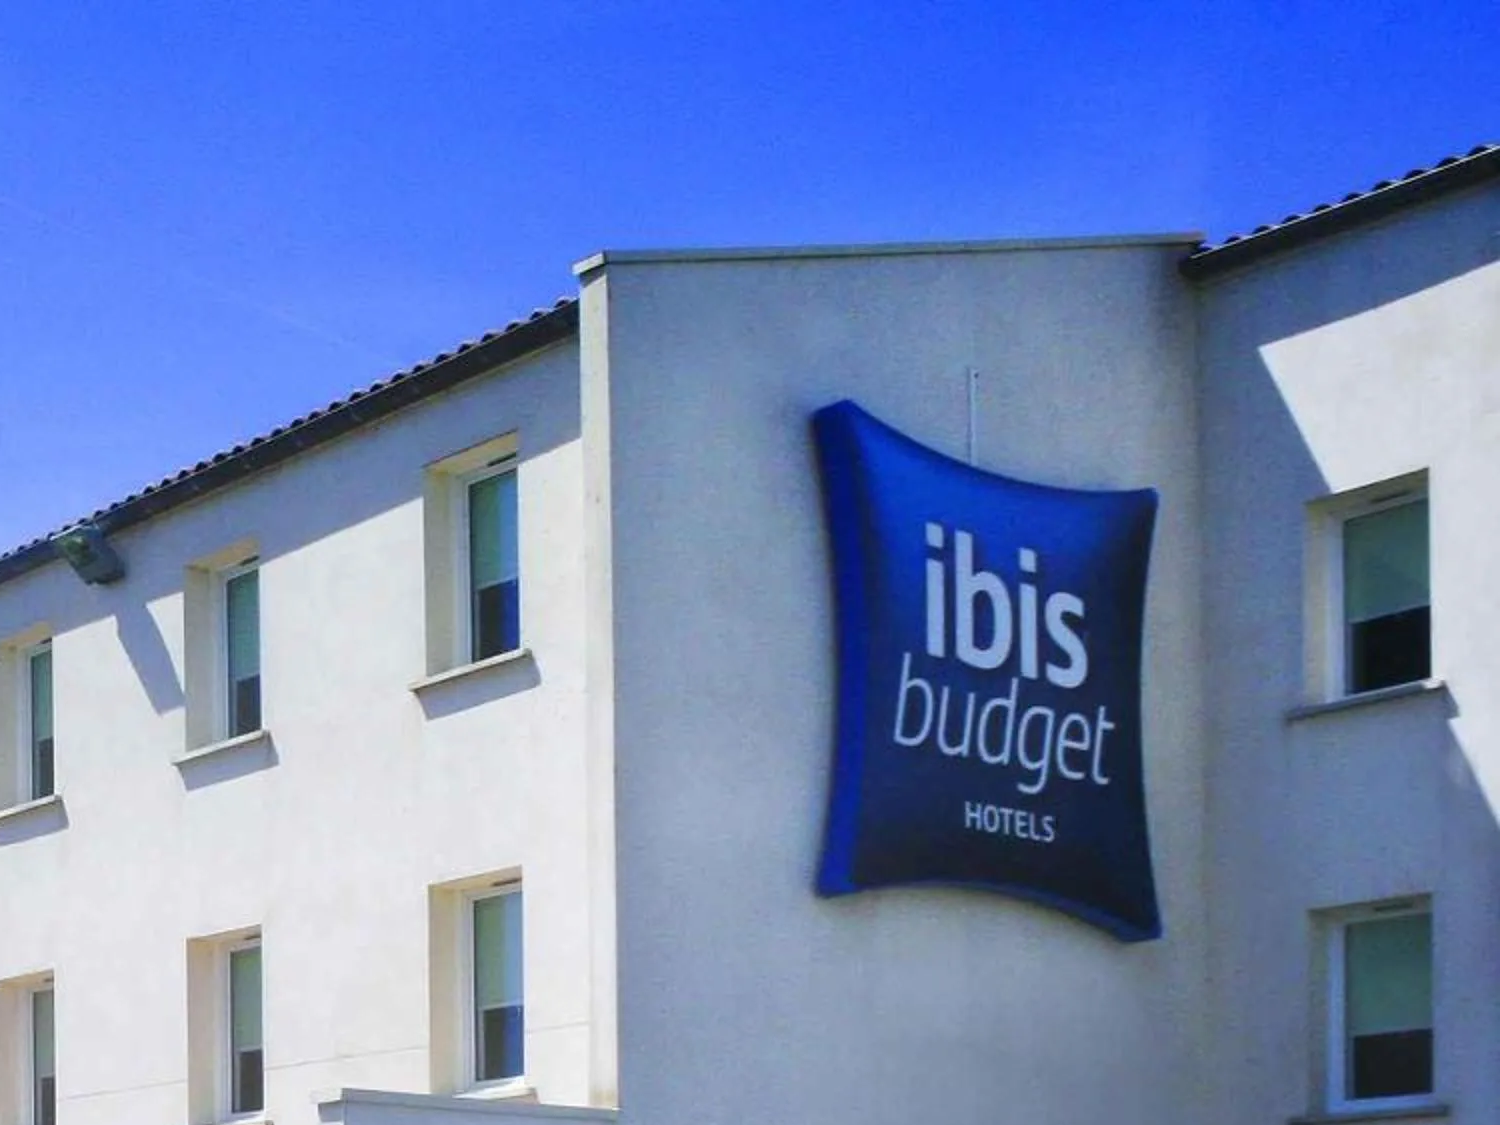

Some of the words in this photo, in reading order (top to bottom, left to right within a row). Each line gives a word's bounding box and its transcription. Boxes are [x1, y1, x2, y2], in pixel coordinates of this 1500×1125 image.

[925, 522, 1088, 688] ibis
[894, 652, 1114, 794] budget
[965, 801, 1055, 842] HOTELS
